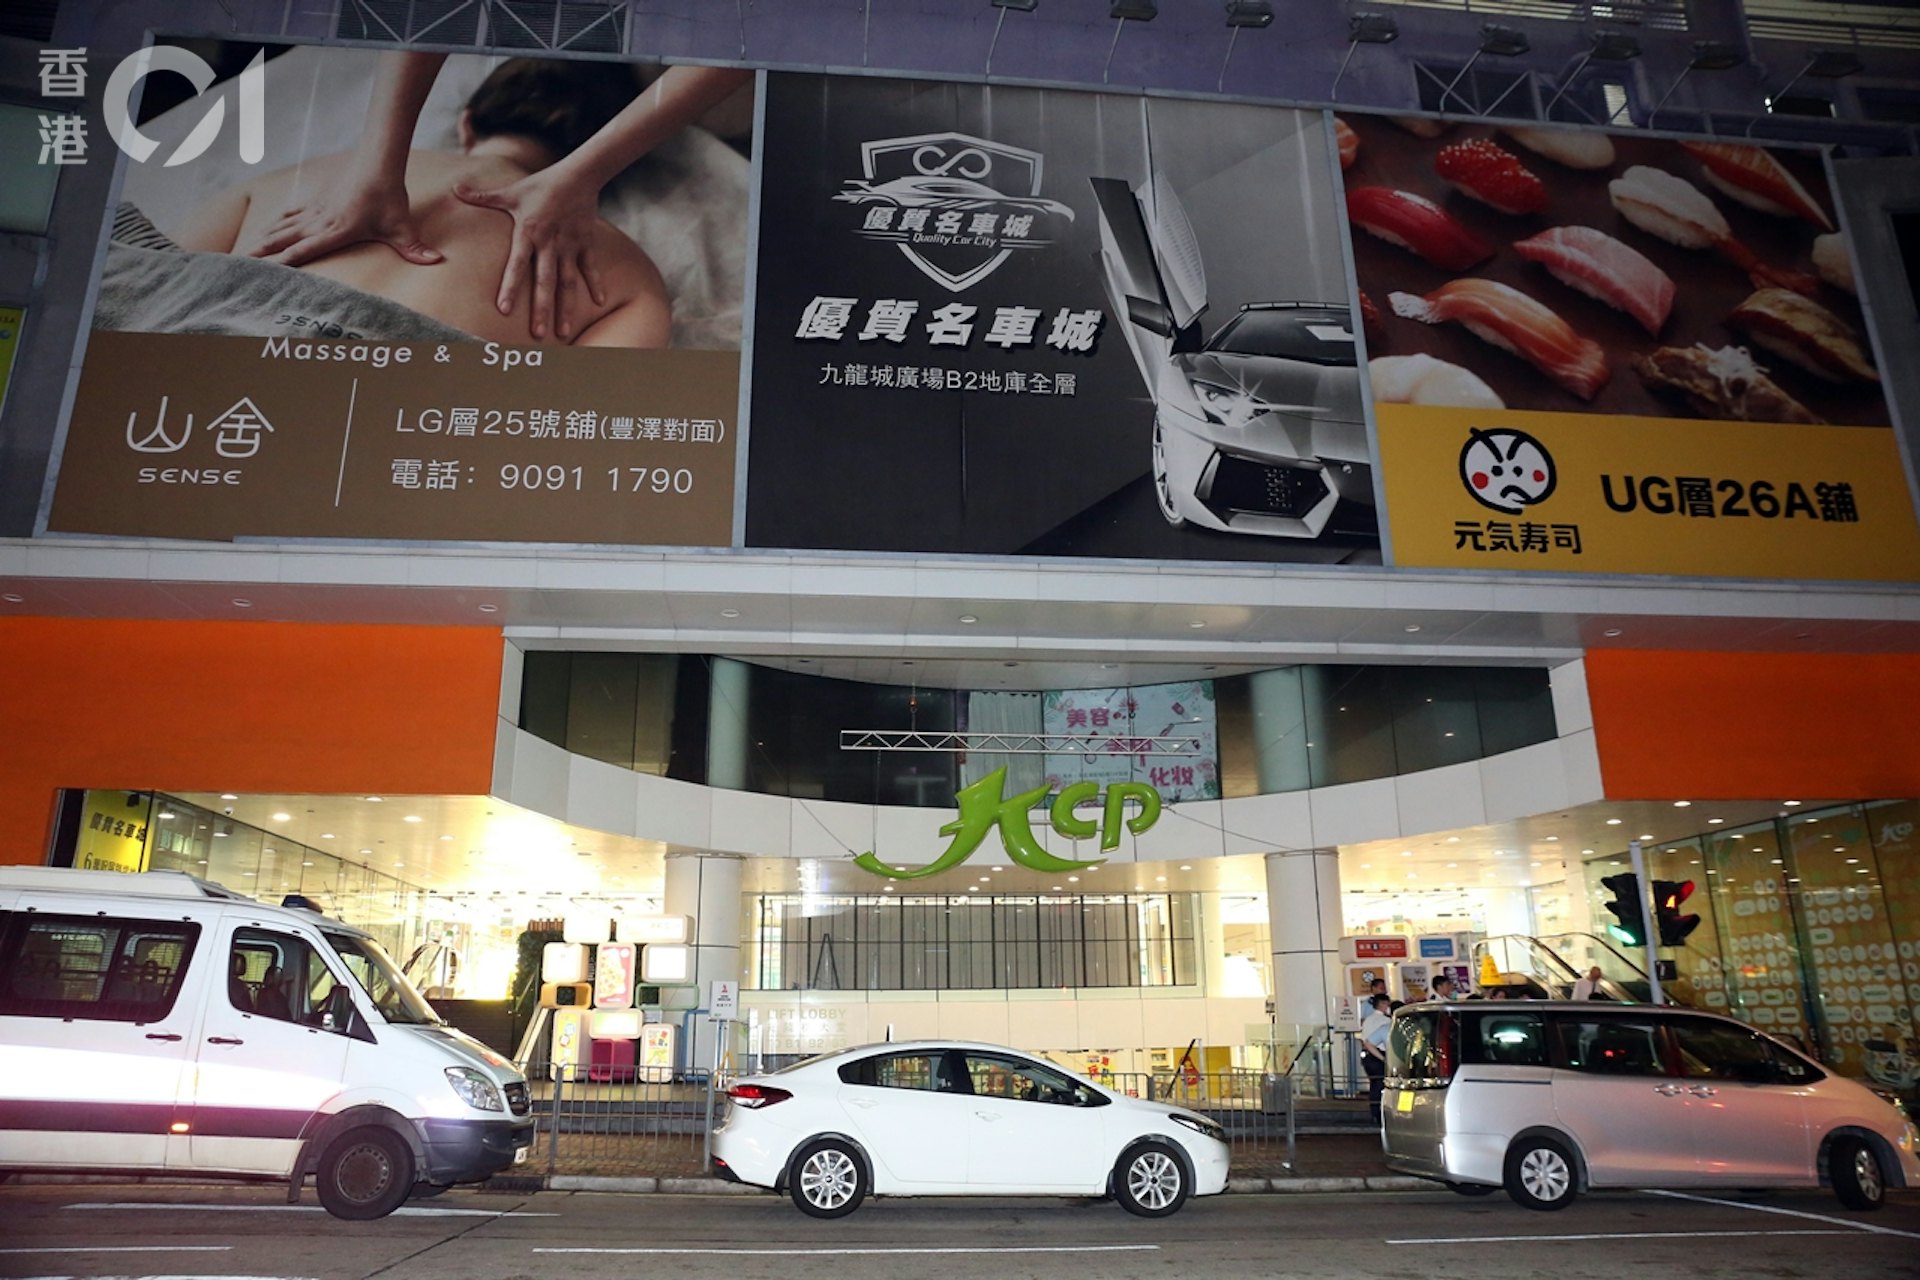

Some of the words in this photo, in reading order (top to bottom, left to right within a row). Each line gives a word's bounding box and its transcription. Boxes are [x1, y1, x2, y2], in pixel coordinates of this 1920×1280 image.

[863, 206, 1034, 238] 優質名車城
[913, 233, 952, 246] Quality
[952, 234, 973, 245] Car
[973, 236, 998, 248] City
[794, 296, 1103, 352] 優質名車城
[261, 336, 412, 368] Massage
[434, 345, 450, 363] &
[482, 342, 543, 371] Spa
[819, 362, 1077, 396] 九龍城廣場B2地庫全層
[126, 396, 274, 458] 山舍
[396, 407, 725, 444] LG層25號舖(豐澤對面)
[137, 468, 242, 485] SENSE
[500, 464, 583, 491] 9091
[607, 467, 693, 494] 1790
[1600, 474, 1859, 523] UG層26A舖
[1454, 521, 1582, 554] 元気寿司
[1066, 708, 1109, 728] 美容
[800, 1008, 847, 1019] LOBBY
